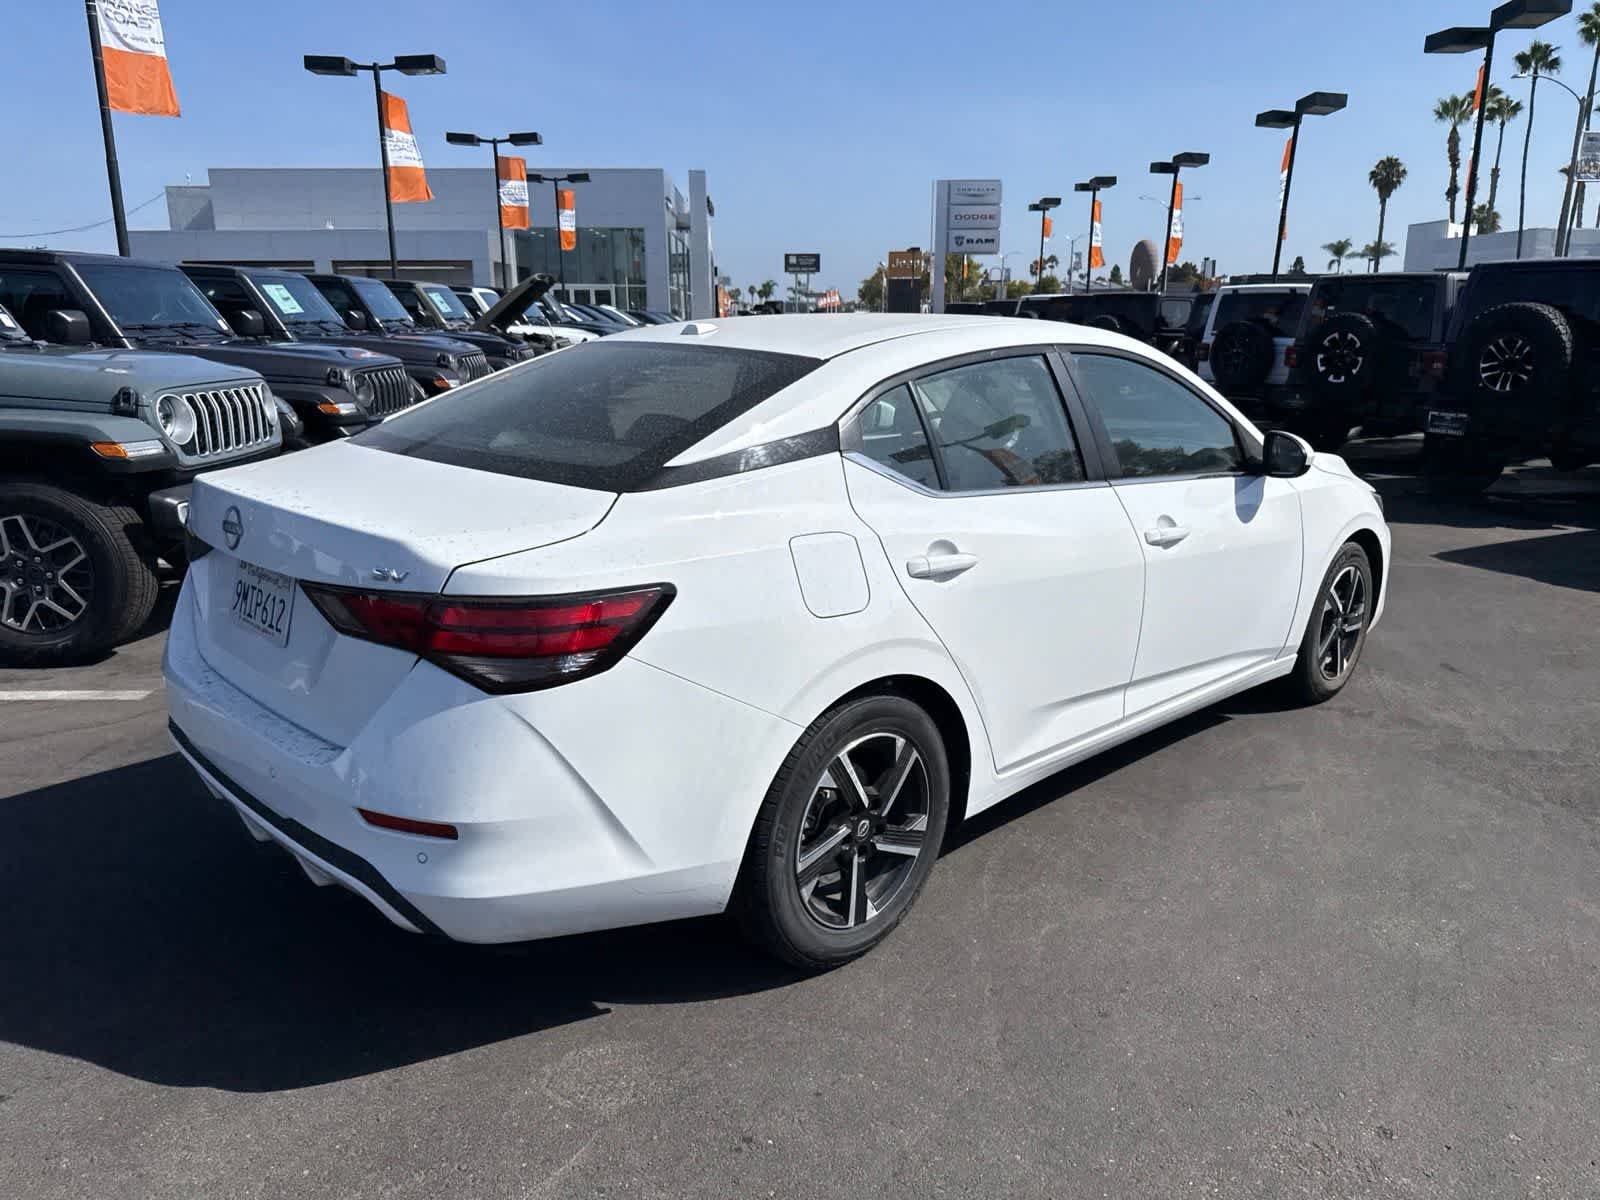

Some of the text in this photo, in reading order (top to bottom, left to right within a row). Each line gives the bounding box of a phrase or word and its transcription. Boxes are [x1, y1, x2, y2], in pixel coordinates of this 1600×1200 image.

[100, 0, 160, 19] RANGE
[372, 567, 409, 583] SV
[232, 579, 286, 633] 9MIP612
